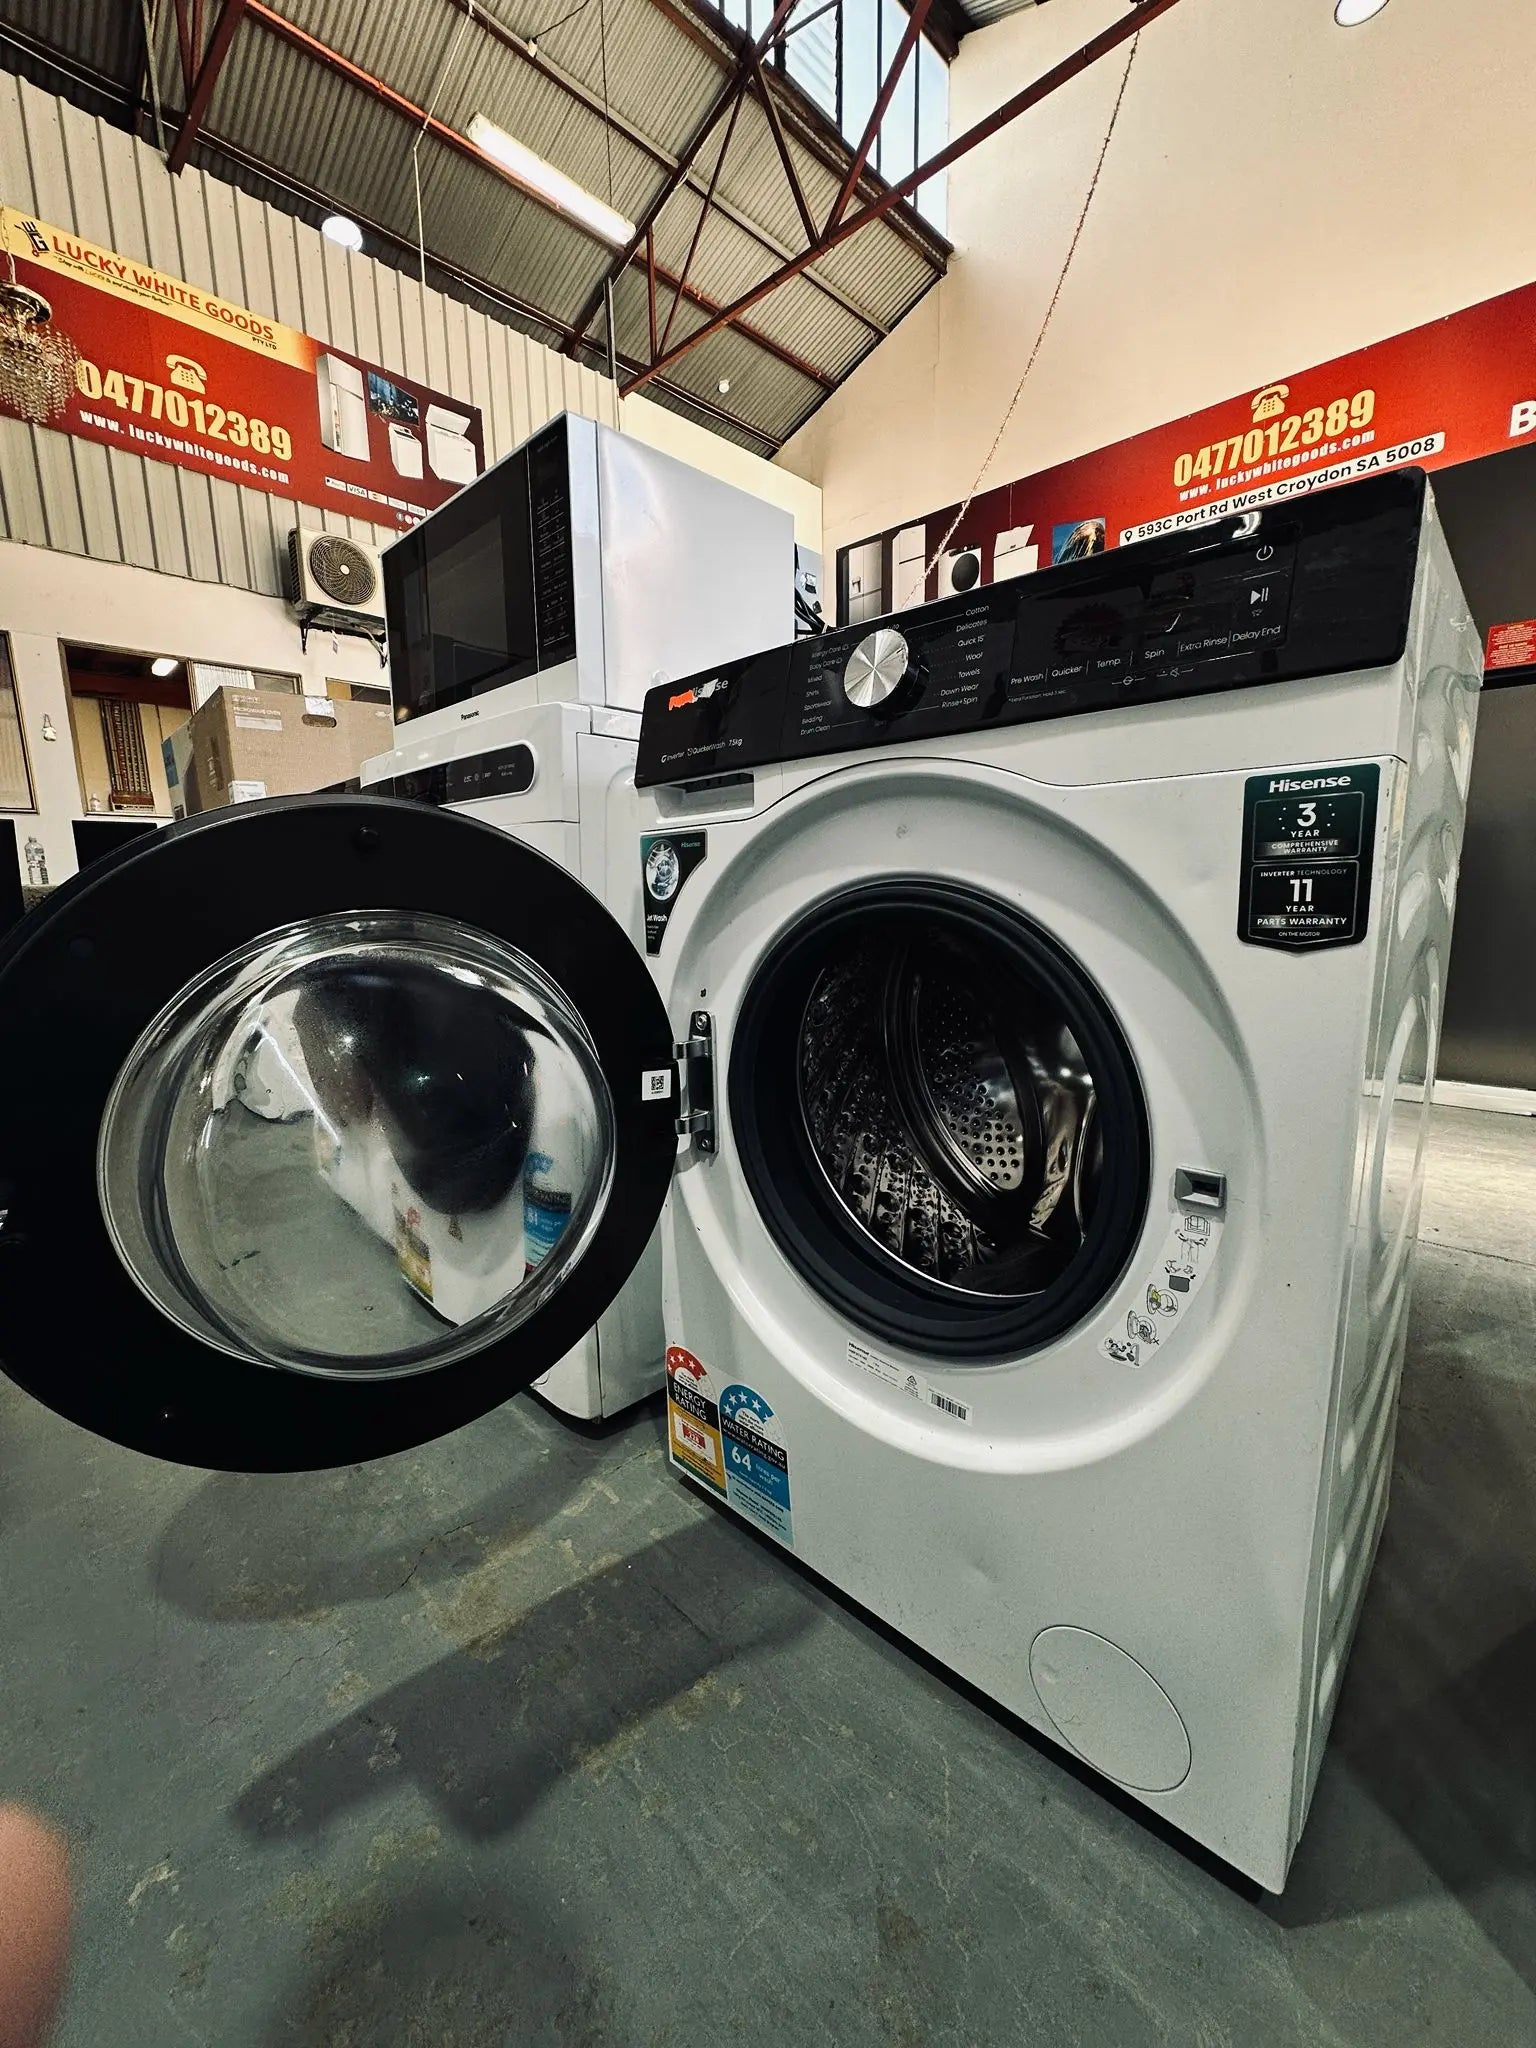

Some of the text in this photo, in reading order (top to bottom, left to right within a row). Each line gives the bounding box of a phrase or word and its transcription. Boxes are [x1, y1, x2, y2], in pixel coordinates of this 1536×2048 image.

[52, 235, 127, 279] LUCKY
[132, 269, 201, 310] WHITE
[205, 301, 275, 341] GOODS
[251, 336, 265, 346] PTY
[76, 359, 292, 461] 0477012389
[1173, 388, 1376, 487] 0477012389
[79, 409, 290, 484] www. luckywhitegoods.com
[1179, 429, 1375, 502] www. luckywhitegoods.com
[1138, 437, 1435, 538] 593C Port Rd West Croydon SA 5008
[965, 605, 990, 617] Cotton
[956, 619, 988, 632] Delicates
[1232, 625, 1281, 643] Delay End
[957, 638, 977, 648] Quick
[1180, 636, 1229, 652] Extra Rinse
[965, 652, 984, 662] Wool
[1144, 648, 1166, 660] Spin
[1096, 657, 1122, 669] Temp
[957, 668, 981, 679] Towels
[1051, 665, 1084, 678] Quicker
[1010, 672, 1045, 686] Pre Wash
[940, 683, 980, 697] Down Wear
[1269, 775, 1352, 793] Hisense
[1297, 802, 1317, 827] 3
[1290, 829, 1320, 838] YEAR
[1271, 839, 1339, 850] COMPREHENSIVE
[1284, 846, 1328, 855] WARRANTY
[1297, 868, 1348, 876] TECHNOLOGY
[1290, 878, 1313, 902] 11
[1285, 905, 1315, 913] YEAR
[1257, 917, 1347, 926] PARTS WARRANTY
[673, 1381, 706, 1409] ENERGY
[675, 1392, 707, 1420] RATING
[723, 1419, 750, 1440] WATER
[751, 1435, 785, 1462] RATING
[731, 1446, 752, 1472] 64
